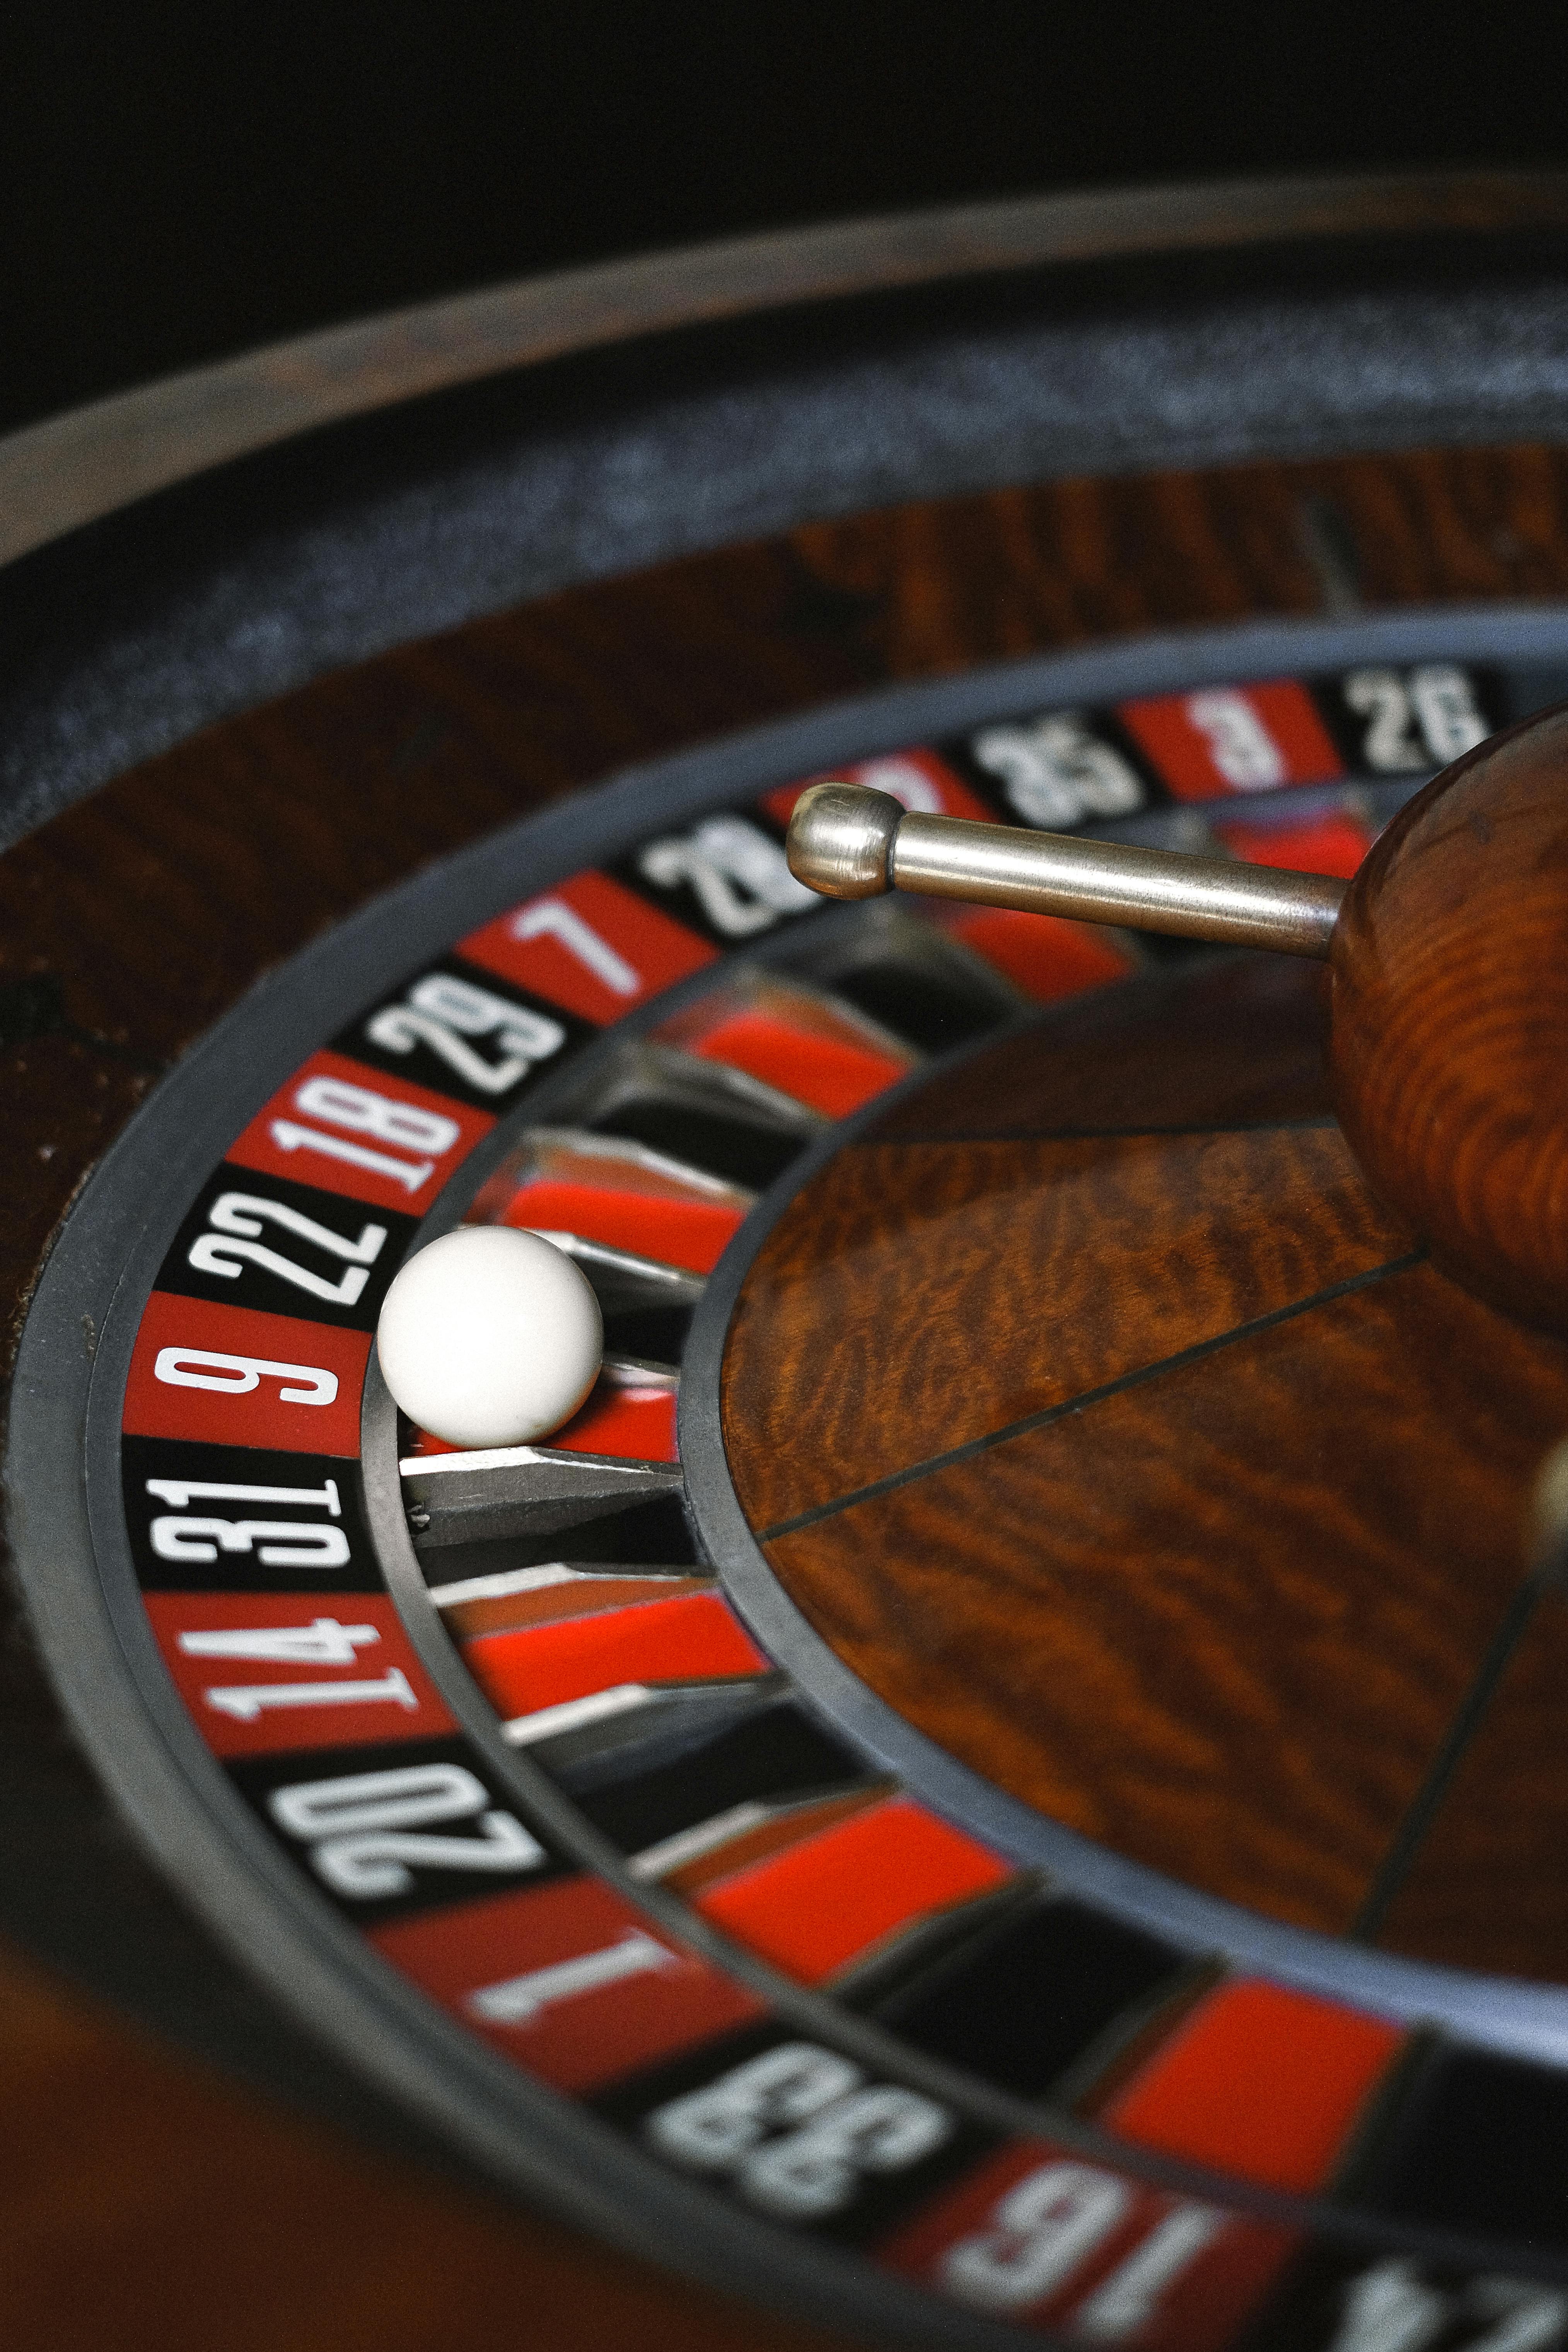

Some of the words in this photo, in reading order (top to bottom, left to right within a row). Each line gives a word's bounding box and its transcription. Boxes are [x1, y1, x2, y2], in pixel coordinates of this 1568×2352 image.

[1186, 686, 1286, 792] 3
[1348, 669, 1488, 769] 26
[512, 899, 639, 995] 7
[368, 973, 565, 1094] 29
[270, 1076, 460, 1193] 18
[188, 1192, 387, 1306] 22
[154, 1347, 339, 1406] 9
[147, 1479, 351, 1567] 31
[177, 1617, 419, 1720] 14
[269, 1761, 546, 1901] 20
[468, 1926, 679, 2026] 1
[650, 2041, 949, 2215] 33
[942, 2160, 1222, 2338] 16
